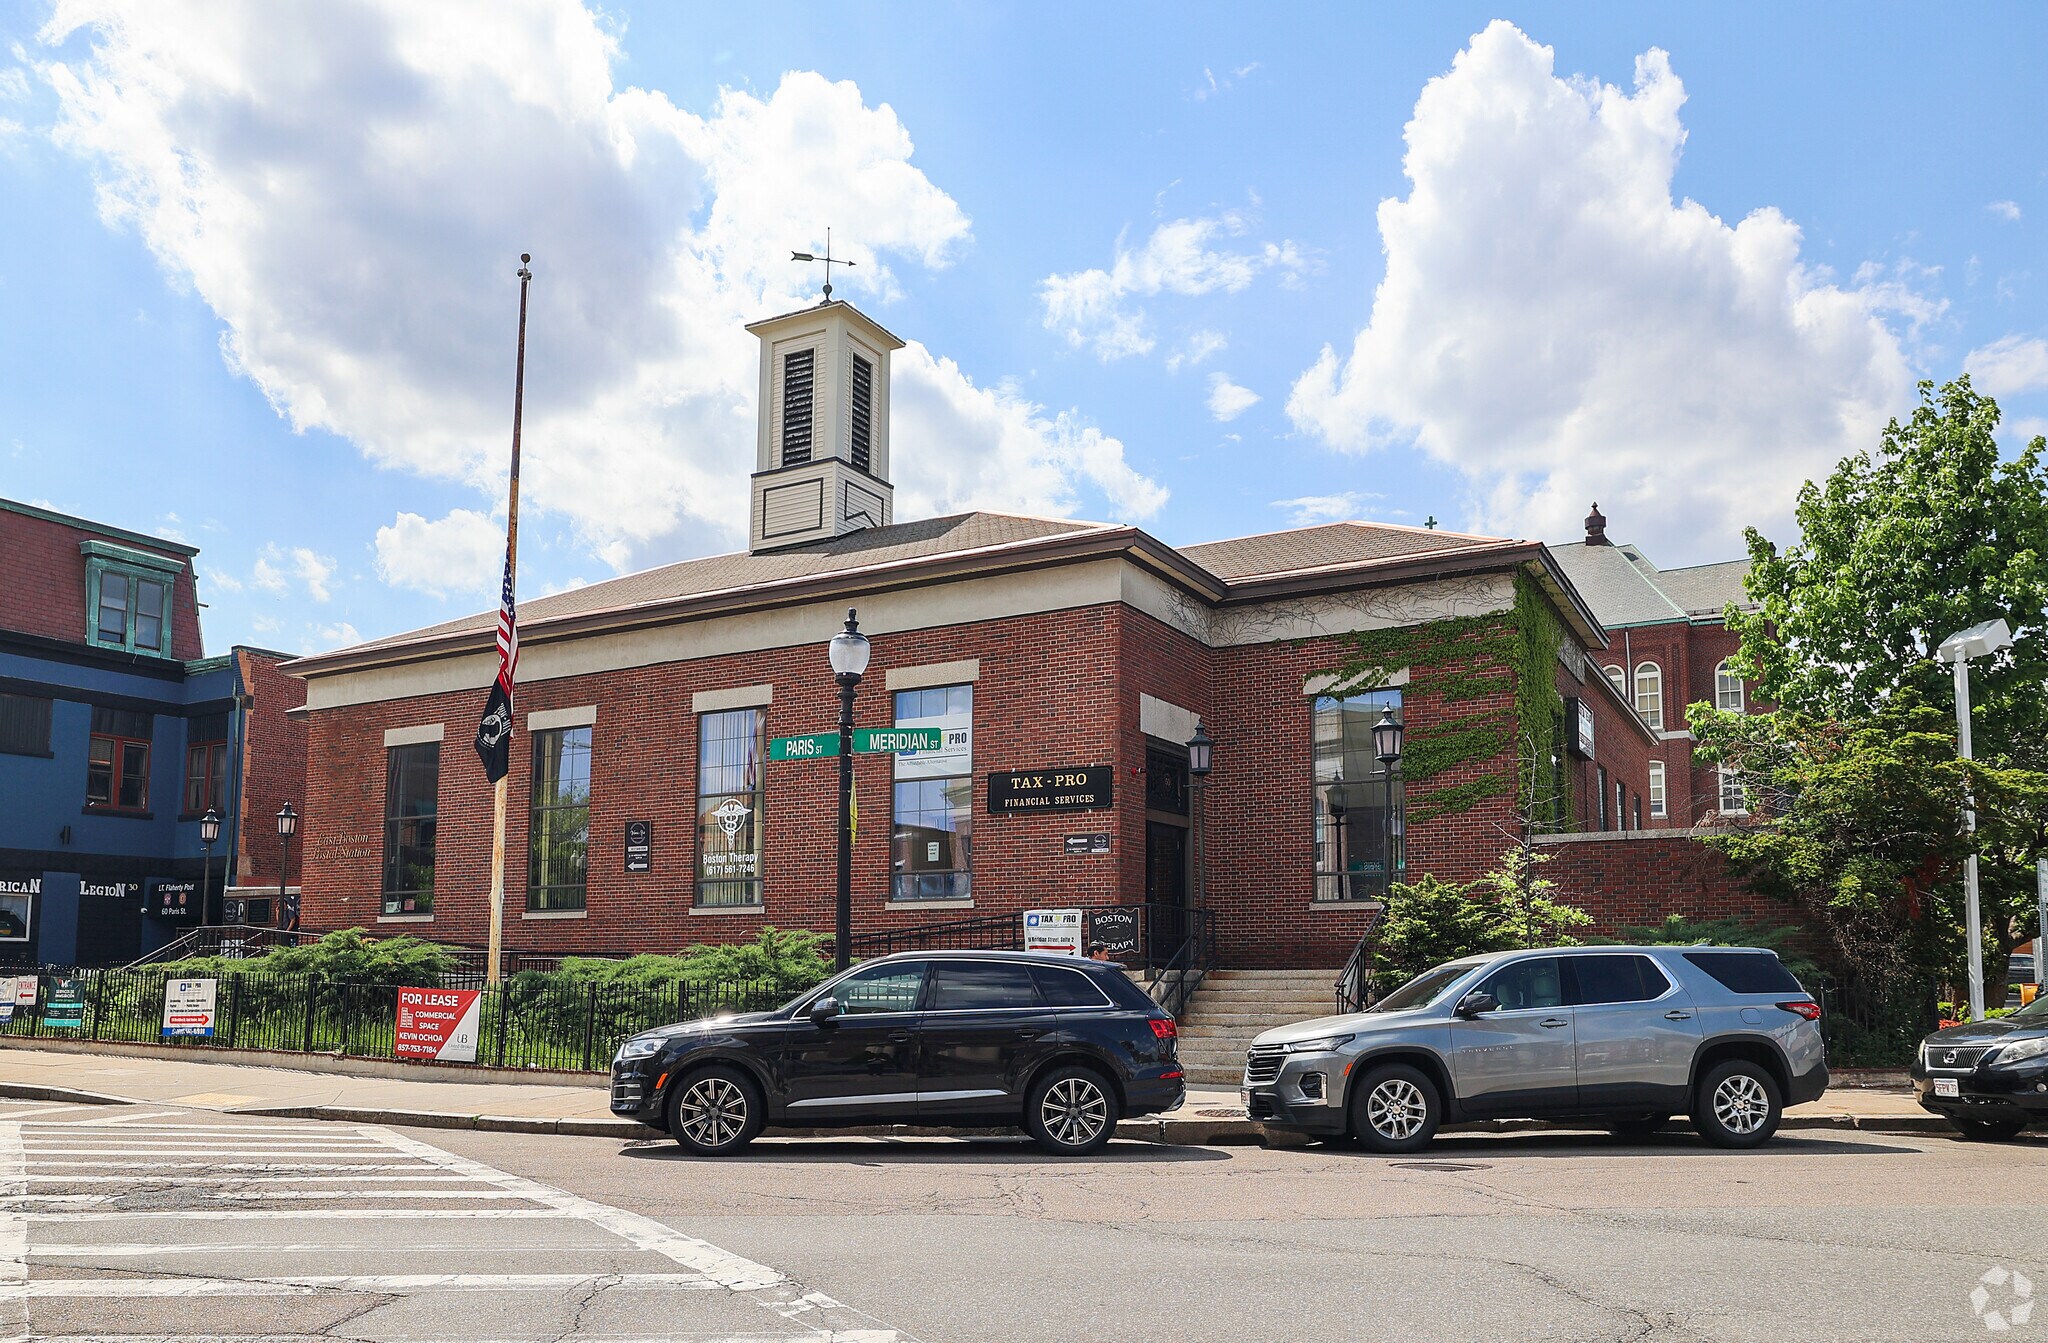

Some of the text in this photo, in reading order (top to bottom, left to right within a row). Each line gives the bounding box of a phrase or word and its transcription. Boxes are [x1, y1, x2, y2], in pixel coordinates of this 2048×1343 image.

[869, 733, 938, 750] MERIDIAN ST
[949, 732, 967, 745] PRO
[786, 738, 823, 756] PARIS ST
[1011, 776, 1044, 790] TAX
[1055, 773, 1087, 787] PRO
[1005, 794, 1095, 807] FINANCIAL SERVICES
[339, 830, 369, 844] Boston
[341, 846, 371, 858] Station
[703, 851, 758, 865] Boston Therapy
[707, 864, 755, 876] (617) 561-7246
[80, 880, 138, 897] LEGION 30
[184, 883, 194, 891] Post
[161, 907, 168, 915] 60
[169, 907, 180, 915] Paris
[1040, 914, 1077, 923] TAX PRO
[1095, 914, 1133, 925] BOSTON
[401, 993, 459, 1007] FOR LEASE
[415, 1011, 456, 1020] COMMERCIAL
[419, 1022, 440, 1030] SPACE
[399, 1032, 443, 1042] KEVIN OCHOA
[397, 1044, 437, 1054] 857-753-7184
